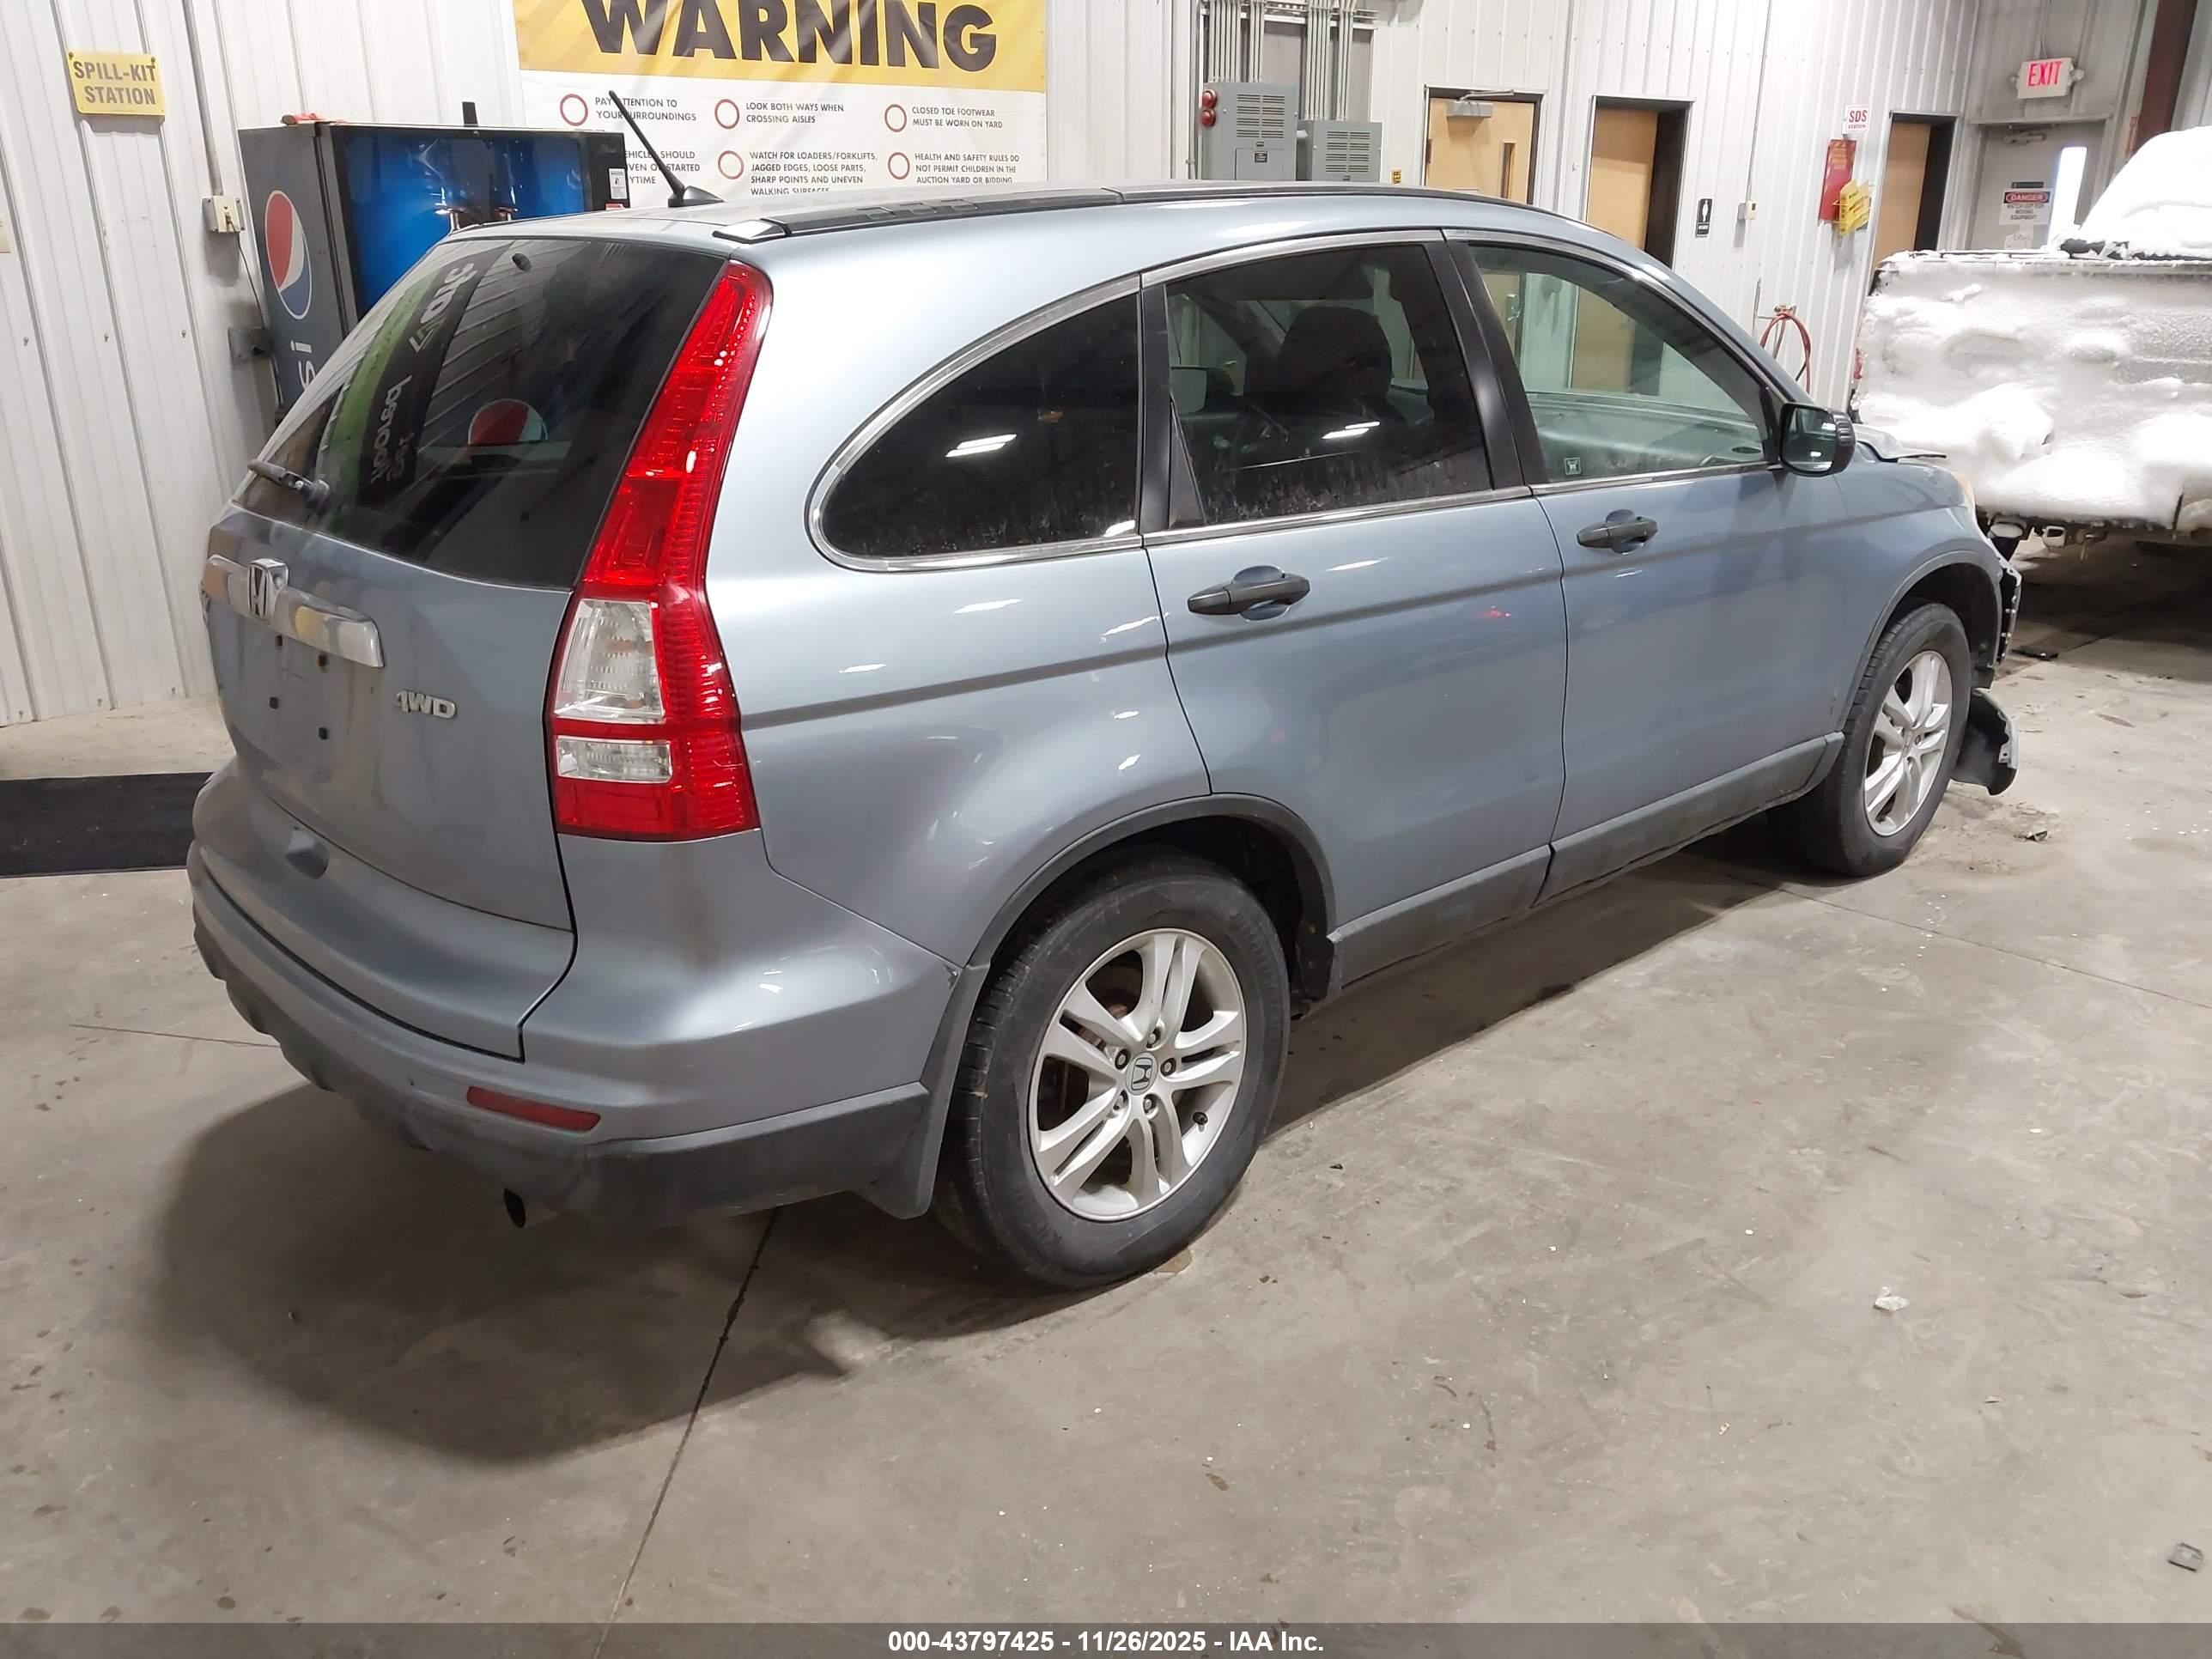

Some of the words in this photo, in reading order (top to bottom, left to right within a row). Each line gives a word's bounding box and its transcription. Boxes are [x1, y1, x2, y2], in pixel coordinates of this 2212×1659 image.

[581, 0, 998, 73] WARNING
[72, 60, 156, 82] SPILL-KIT
[2027, 60, 2063, 87] EXIT
[83, 85, 156, 105] STATION
[595, 97, 611, 106] PAY
[622, 98, 664, 107] TTENTION
[666, 99, 678, 108] TO
[745, 102, 768, 111] LOOK
[770, 102, 793, 111] BOTH
[795, 102, 818, 112] WAYS
[820, 103, 844, 112] WHEN
[596, 111, 623, 119] YOUR
[631, 111, 697, 121] URROUNDINGS
[912, 106, 939, 115] CLOSED
[941, 107, 955, 116] TOE
[957, 108, 995, 117] FOOTWEAR
[1849, 109, 1868, 123] SDS
[746, 114, 789, 123] CROSSING
[792, 115, 816, 124] AISLES
[984, 120, 1003, 129] YARD
[660, 150, 696, 160] SHOULD
[749, 151, 778, 160] WATCH
[780, 151, 795, 160] FOR
[797, 151, 878, 161] LOADERS/FORKLIFTS,
[915, 153, 942, 161] HEALTH
[944, 153, 961, 161] AND
[988, 154, 1009, 162] RULES
[650, 163, 660, 172] O
[665, 163, 701, 172] STARTED
[750, 163, 781, 172] JAGGED
[783, 163, 811, 173] EDGES,
[812, 163, 839, 173] LOOSE
[841, 164, 866, 173] PARTS,
[961, 165, 994, 173] CHILDREN
[750, 175, 776, 184] SHARP
[779, 175, 809, 184] POINTS
[811, 175, 830, 184] AND
[750, 186, 790, 196] WALKING
[2010, 193, 2044, 202] DANGER
